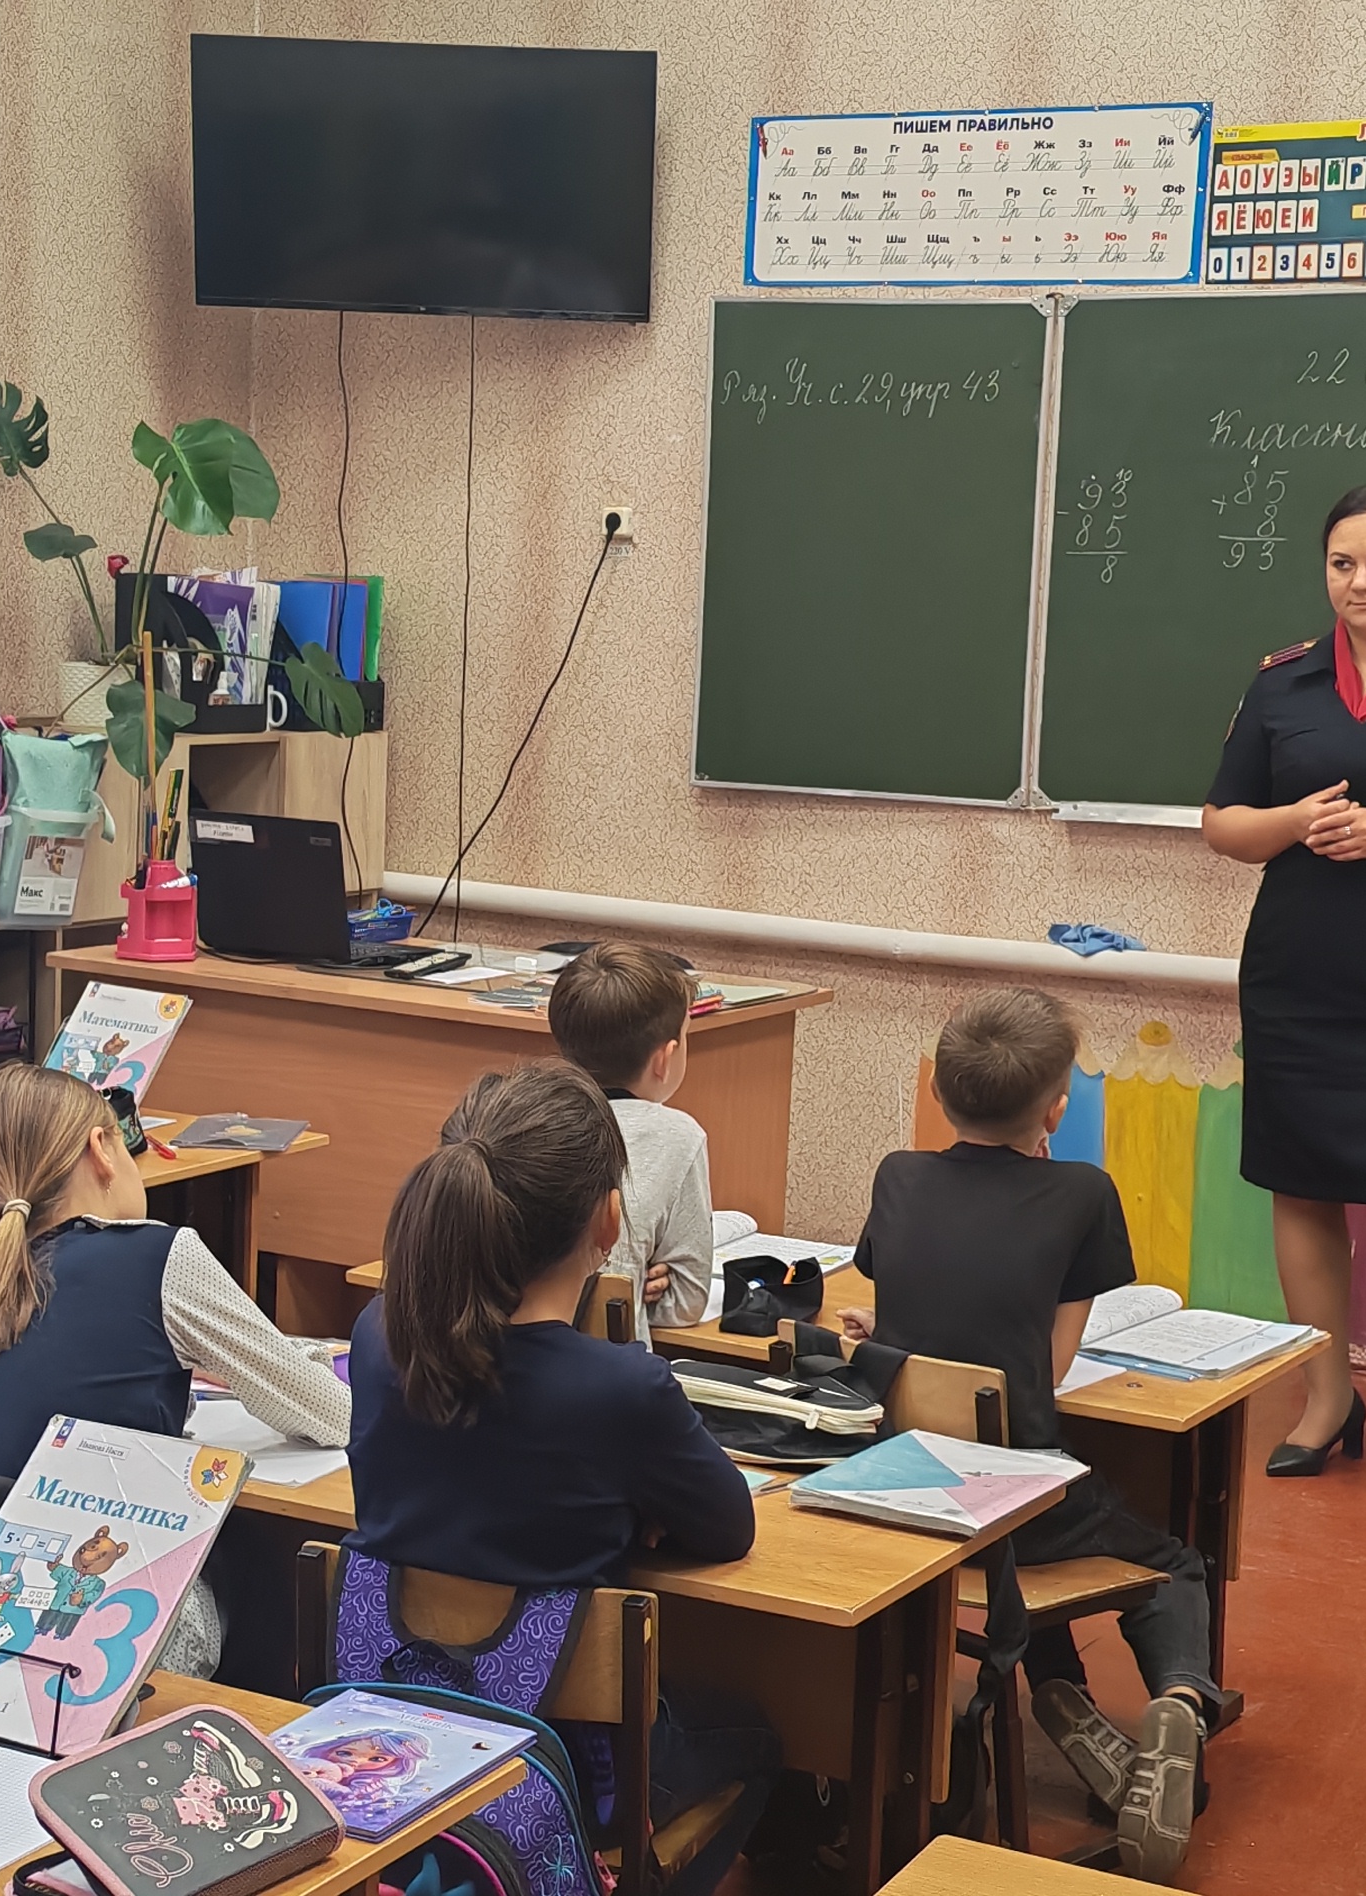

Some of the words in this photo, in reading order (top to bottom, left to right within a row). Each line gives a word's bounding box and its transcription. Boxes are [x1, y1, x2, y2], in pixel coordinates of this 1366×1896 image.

[893, 120, 950, 134] ПИШЕМ
[956, 117, 1054, 132] ПРАВИЛЬНО
[1217, 169, 1230, 190] А
[1240, 169, 1251, 189] О
[1262, 168, 1275, 188] У
[1284, 166, 1293, 187] Э
[1301, 166, 1319, 186] Ы
[1327, 160, 1341, 186] Й
[1351, 164, 1363, 184] Р
[1215, 210, 1228, 230] Я
[1236, 204, 1247, 230] Ё
[1255, 208, 1272, 229] Ю
[1281, 208, 1292, 228] Е
[1301, 206, 1314, 227] И
[1213, 257, 1222, 273] 0
[1236, 256, 1242, 272] 1
[1257, 255, 1267, 271] 2
[1280, 254, 1290, 271] 3
[1302, 254, 1312, 270] 4
[1325, 253, 1335, 269] 5
[1347, 253, 1357, 269] 6
[1297, 347, 1350, 386] 22
[899, 379, 951, 419] упр
[962, 369, 1000, 402] 43
[1257, 504, 1278, 538] 8
[1101, 555, 1118, 584] 8
[20, 886, 44, 898] Макс
[79, 1010, 158, 1034] Математика
[27, 1475, 189, 1531] Математика
[4, 1532, 15, 1544] 5
[44, 1587, 160, 1706] 3
[0, 1702, 8, 1713] 1
